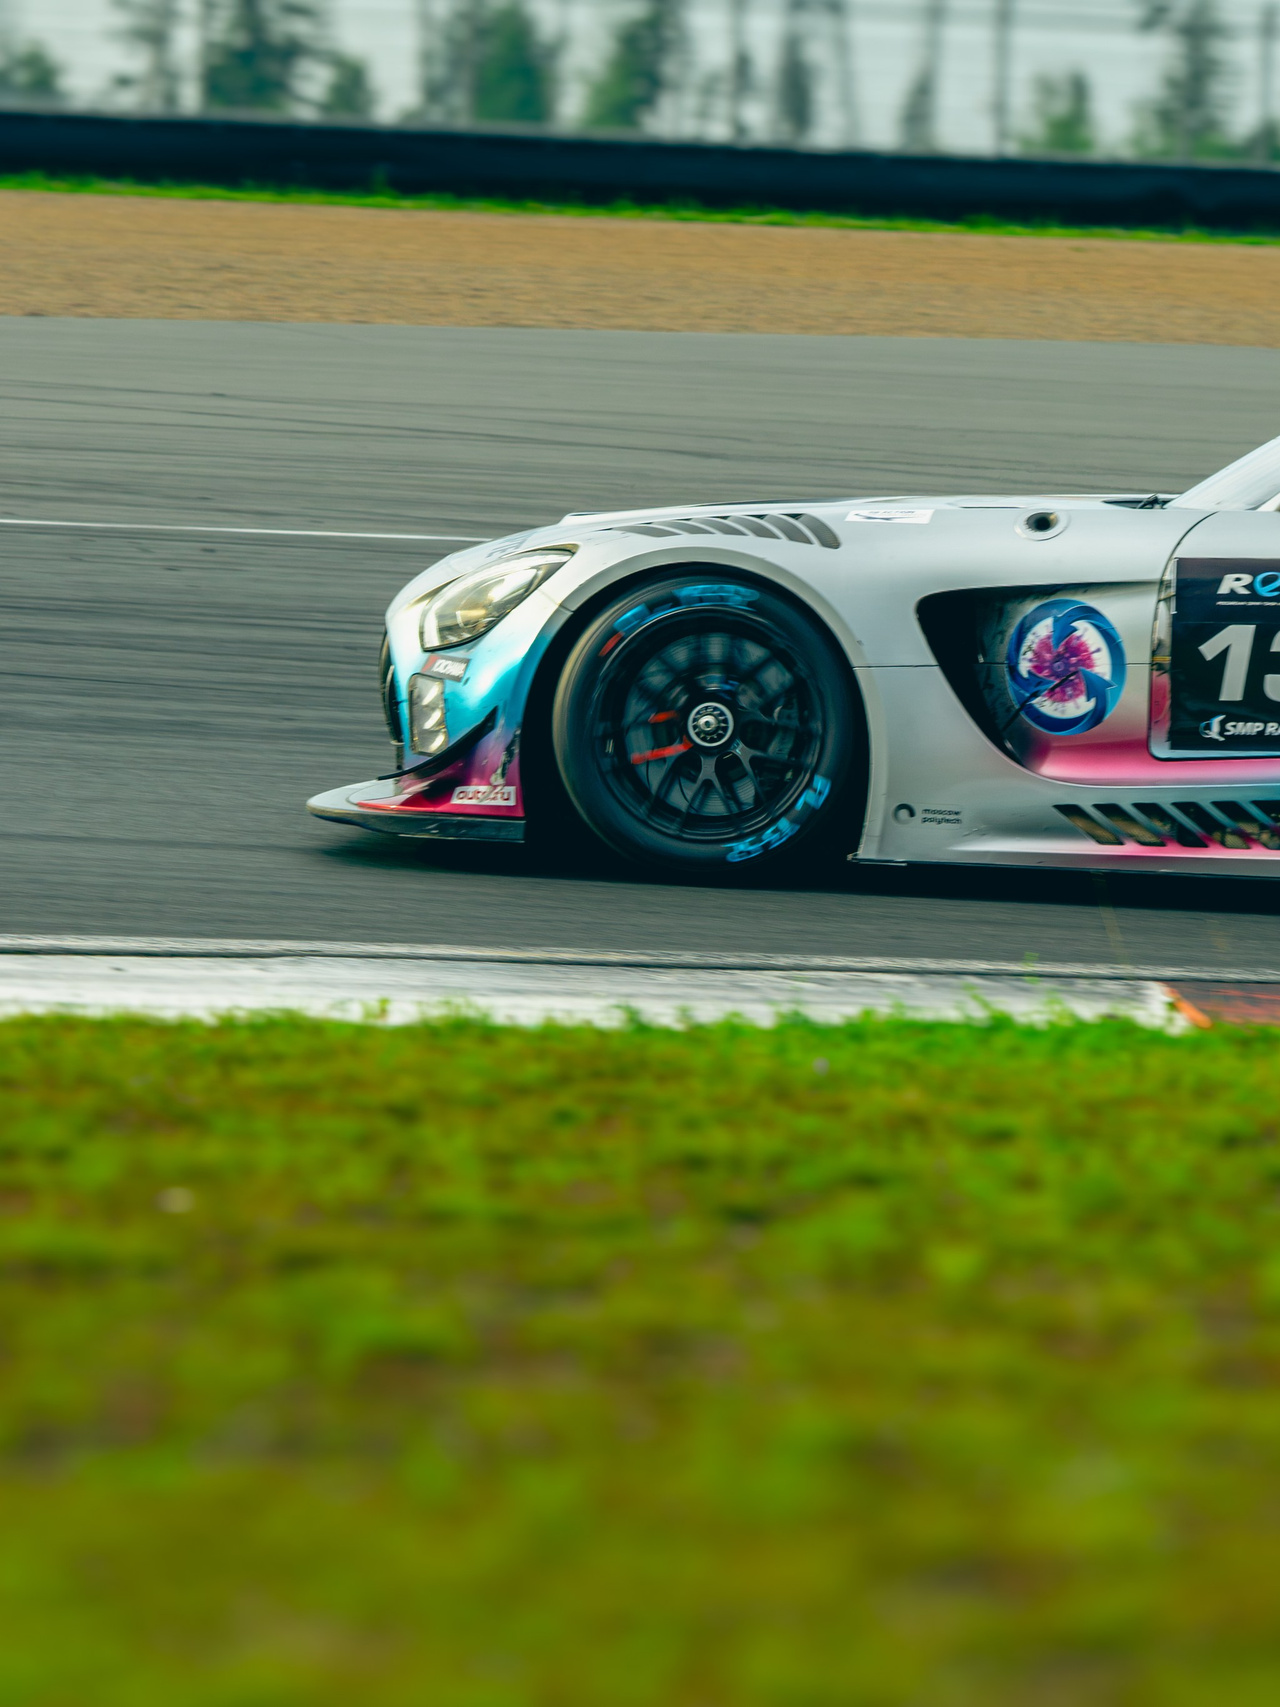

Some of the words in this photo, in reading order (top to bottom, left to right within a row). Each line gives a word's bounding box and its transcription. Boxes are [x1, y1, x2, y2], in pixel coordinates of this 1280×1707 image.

[1224, 721, 1264, 736] SMP
[922, 808, 962, 816] moscow
[921, 816, 963, 825] polytech
